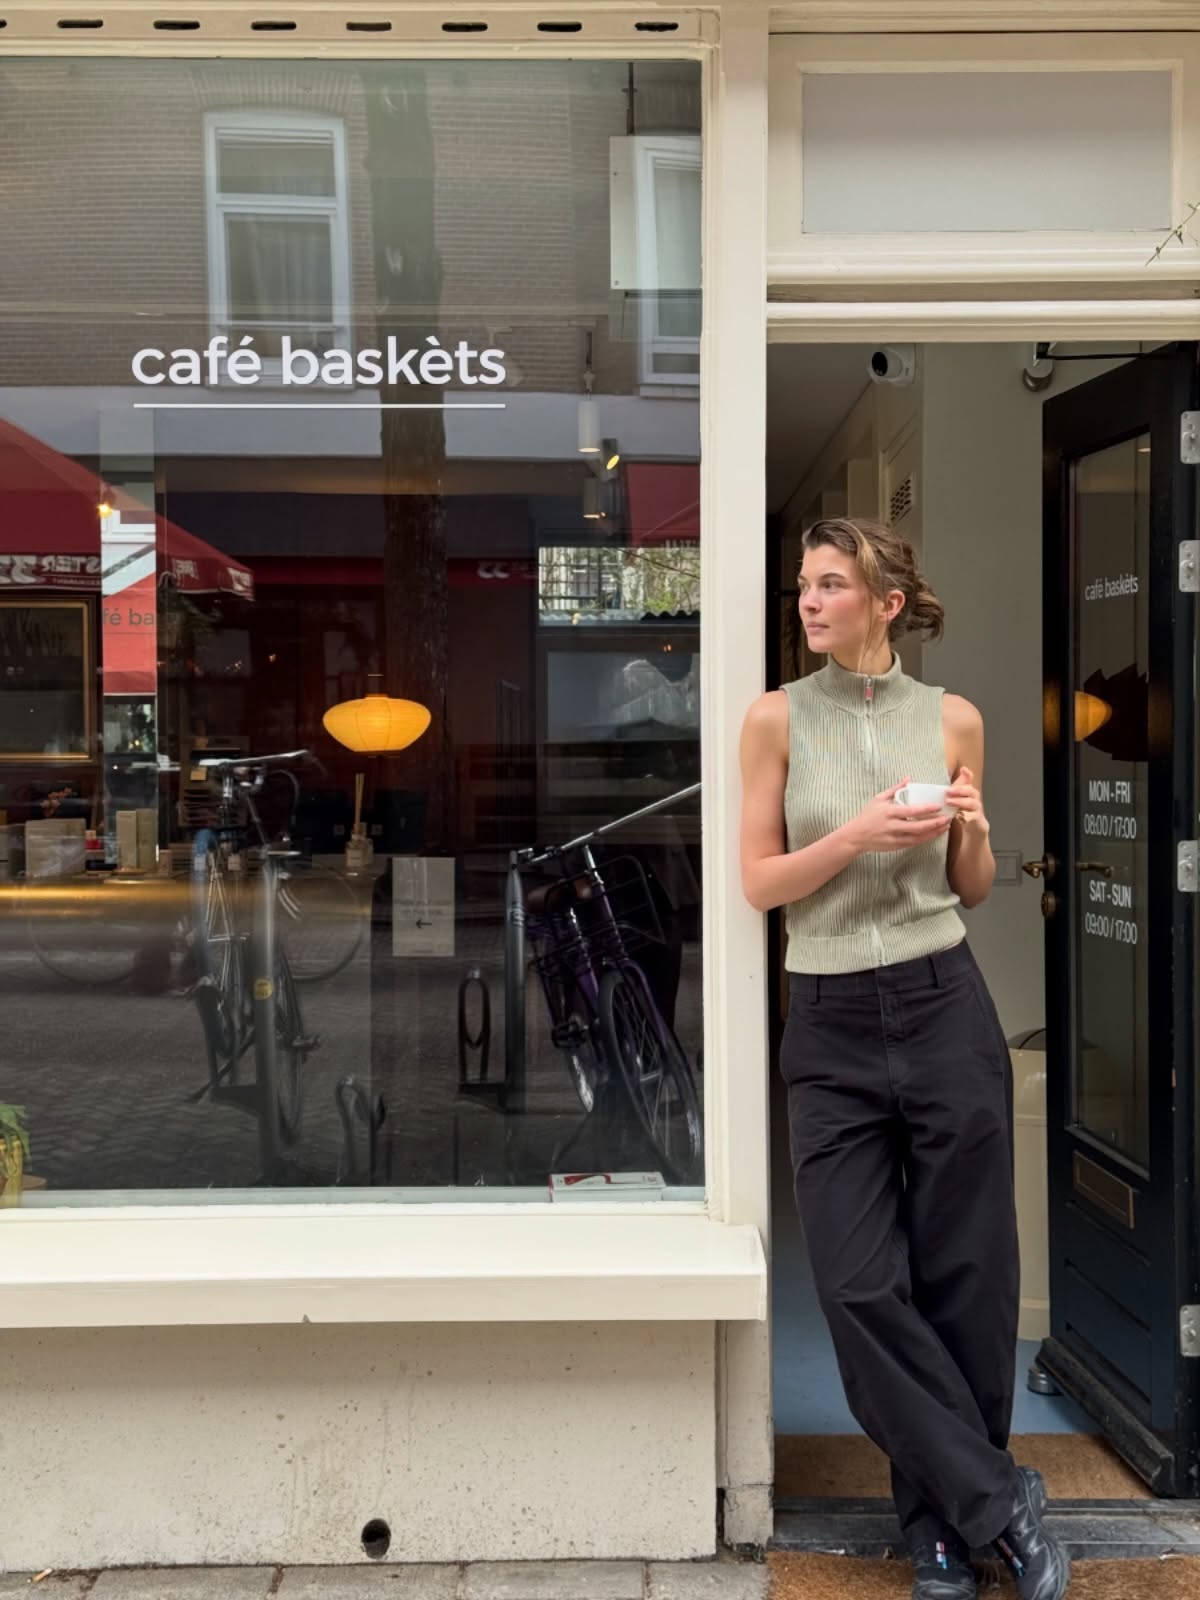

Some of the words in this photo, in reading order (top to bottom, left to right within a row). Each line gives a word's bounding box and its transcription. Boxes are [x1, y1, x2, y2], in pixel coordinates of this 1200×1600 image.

[131, 335, 262, 386] café
[281, 335, 507, 386] baskèts
[1084, 578, 1104, 601] café
